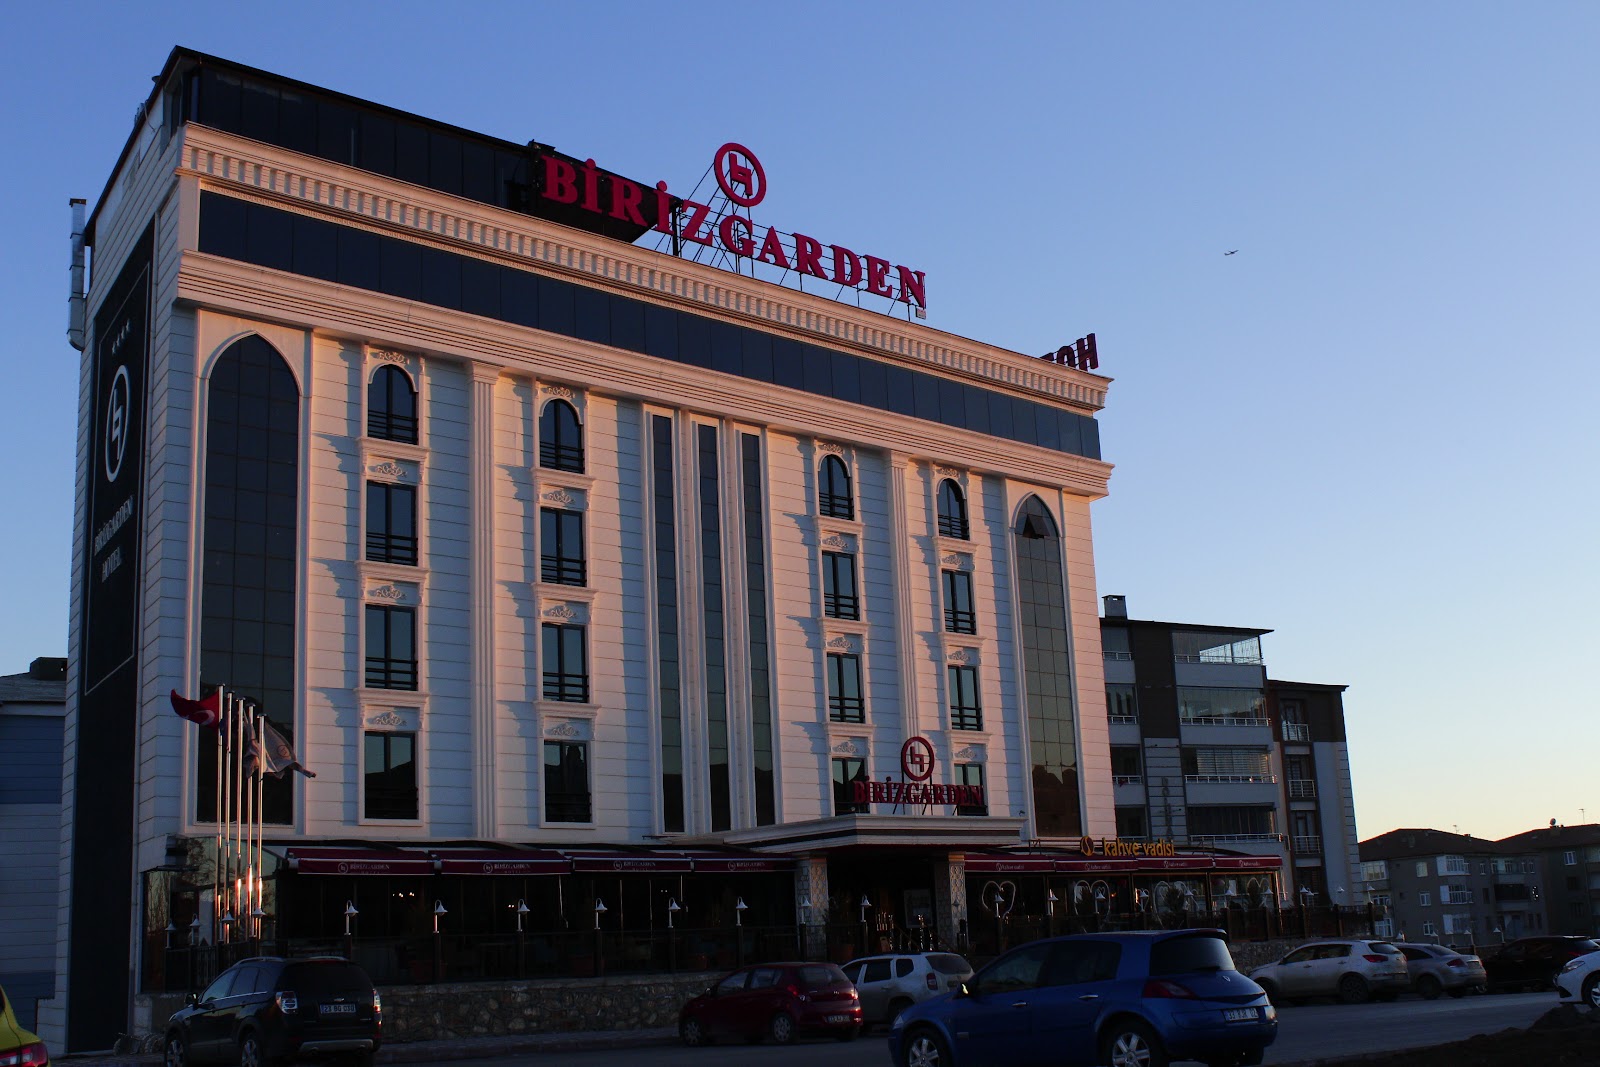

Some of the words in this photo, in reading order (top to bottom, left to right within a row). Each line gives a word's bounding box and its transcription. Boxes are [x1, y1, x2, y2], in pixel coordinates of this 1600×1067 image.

[541, 154, 926, 308] BİRİZGARDEN
[853, 776, 983, 806] BİRİZGARDEN
[1102, 837, 1140, 857] kahve
[1142, 838, 1175, 857] vadisi
